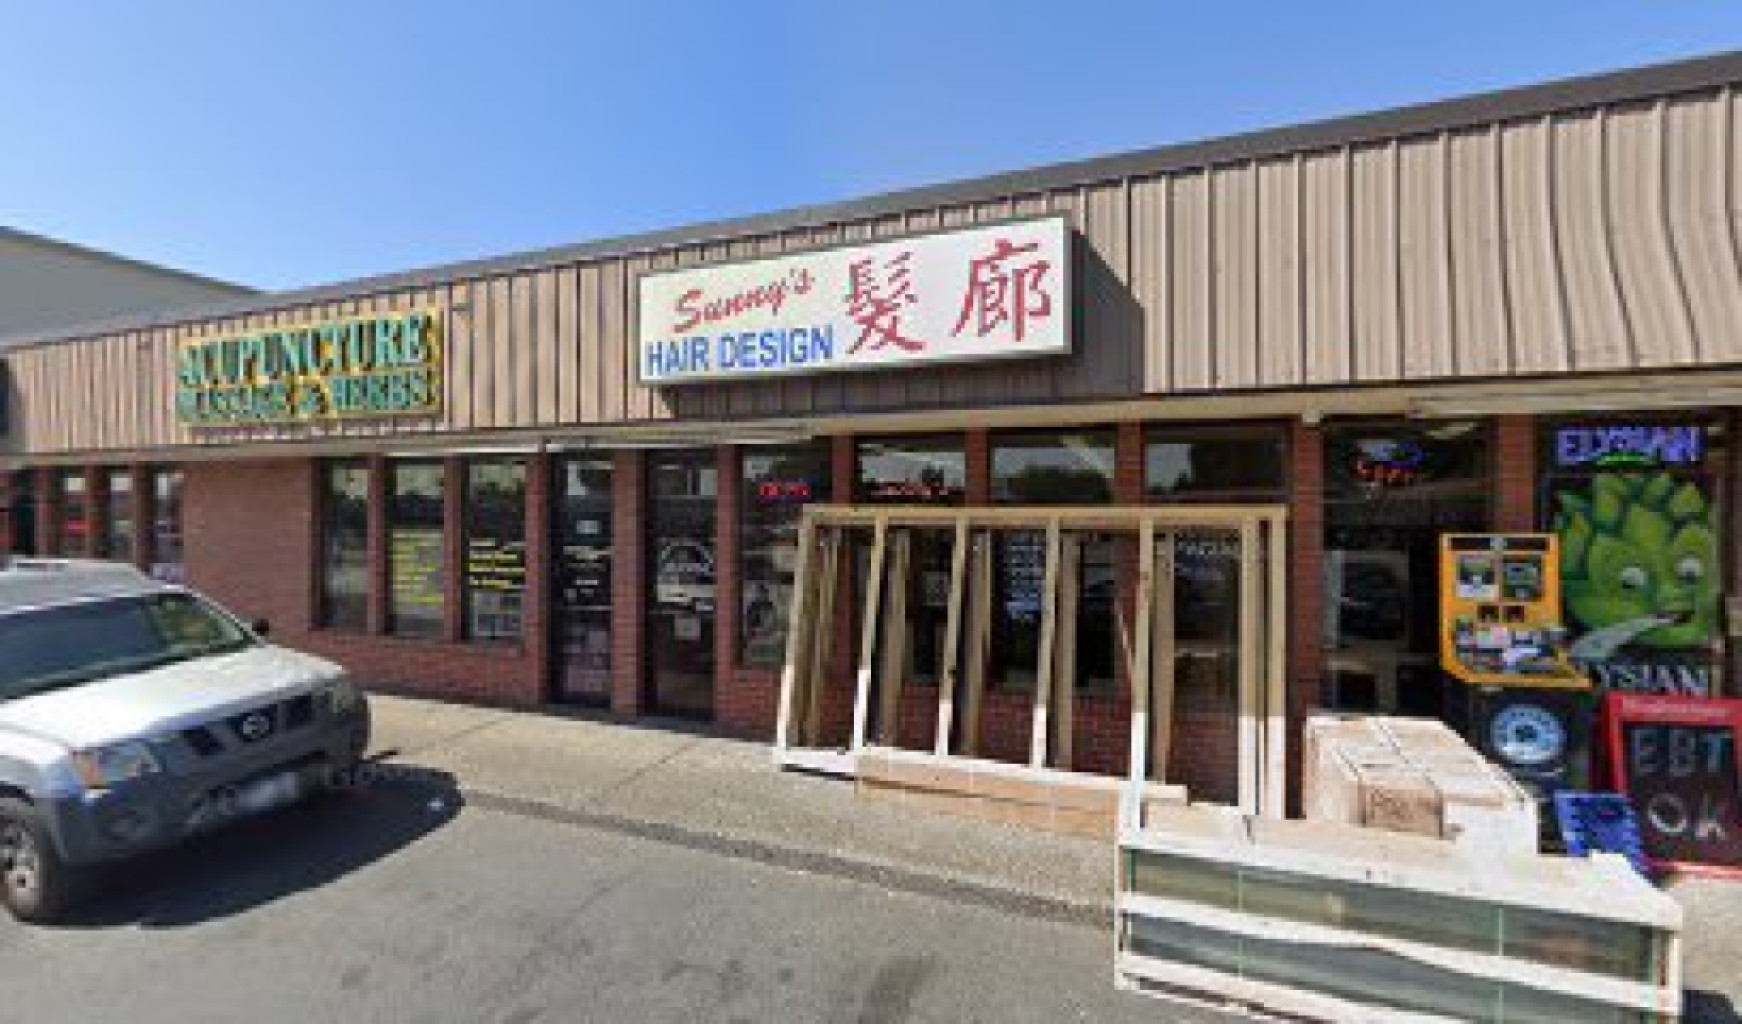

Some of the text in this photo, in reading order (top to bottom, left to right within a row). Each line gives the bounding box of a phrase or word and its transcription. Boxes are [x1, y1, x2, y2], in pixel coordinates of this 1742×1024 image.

[673, 266, 815, 333] Sunny's
[180, 311, 429, 386] ACUPUNCTURE
[647, 324, 834, 378] HAIR DESIGN
[1598, 663, 1709, 698] YSIAN
[1631, 728, 1735, 777] EBT
[1647, 793, 1727, 841] OK
